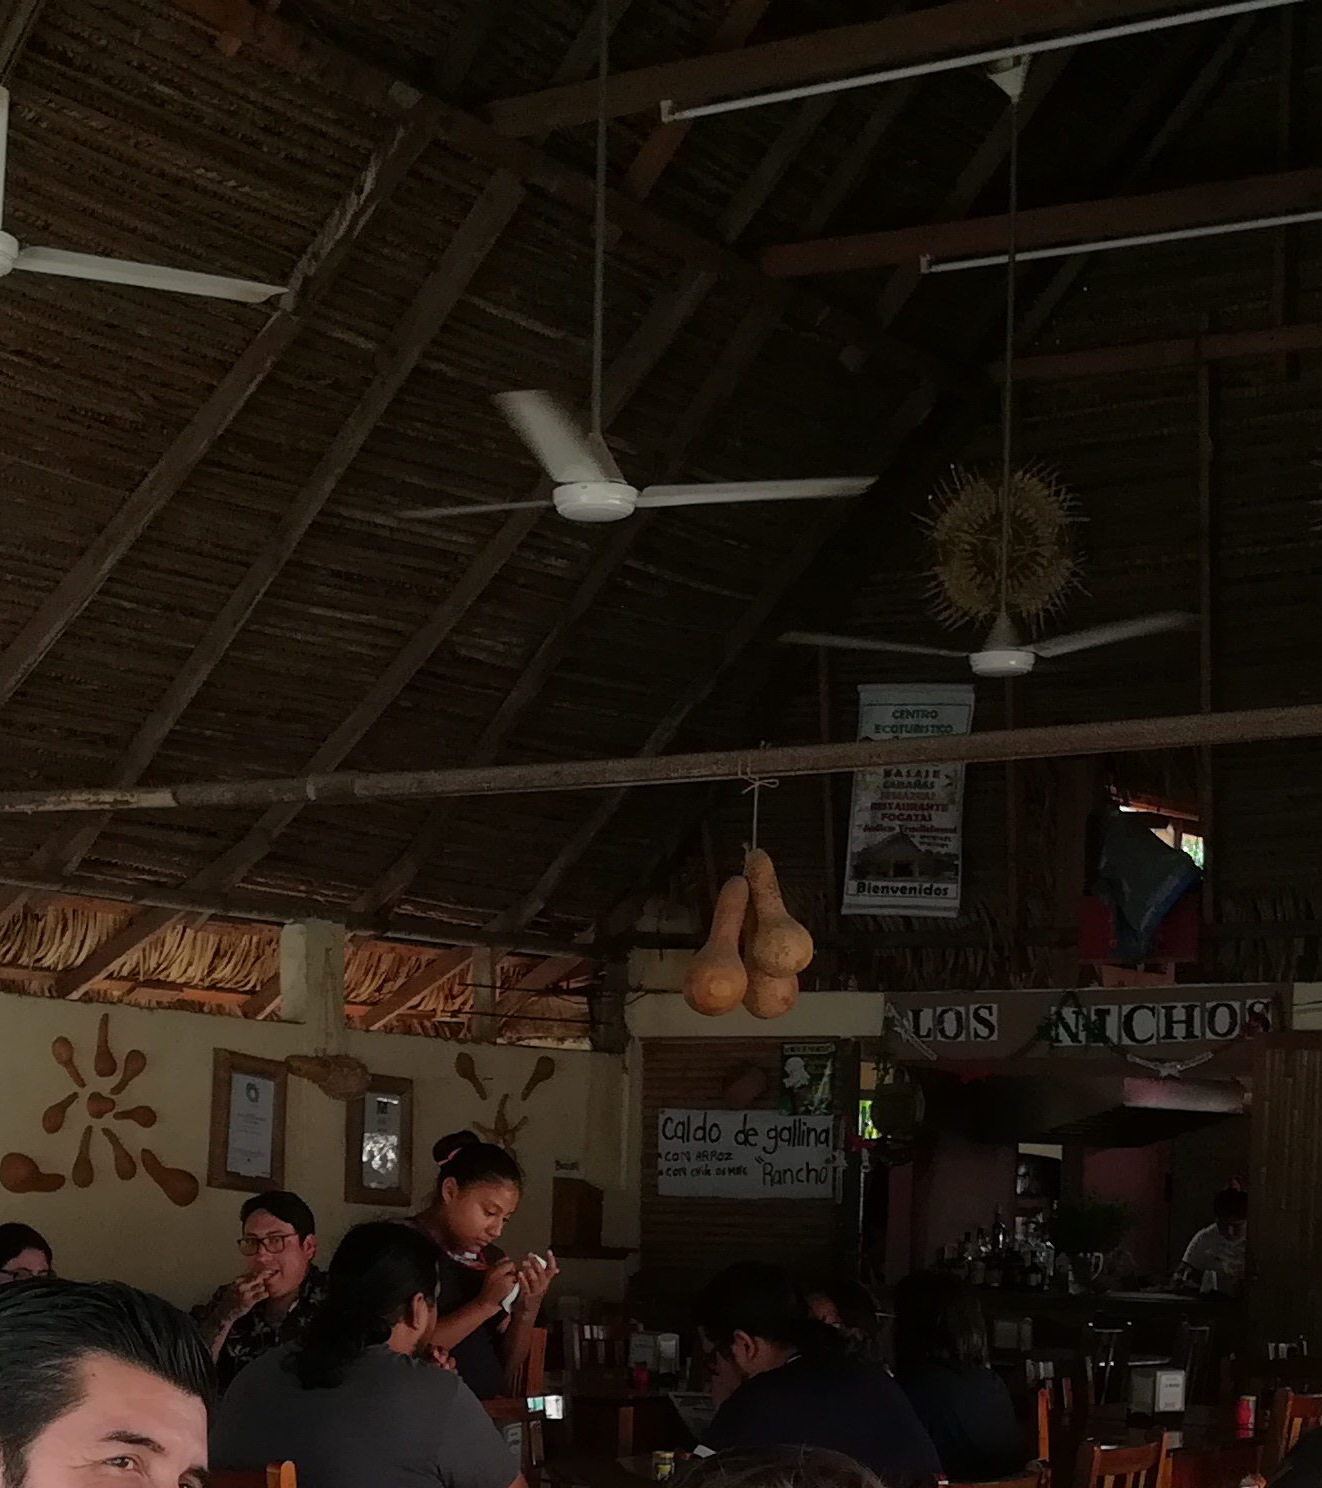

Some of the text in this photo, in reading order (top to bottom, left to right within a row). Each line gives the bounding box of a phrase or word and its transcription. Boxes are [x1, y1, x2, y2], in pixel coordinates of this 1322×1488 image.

[891, 709, 939, 720] CENTRO
[856, 881, 949, 897] Bienvenidos
[910, 999, 1272, 1045] LOS NICHOS
[661, 1112, 830, 1155] Caldo de gallina
